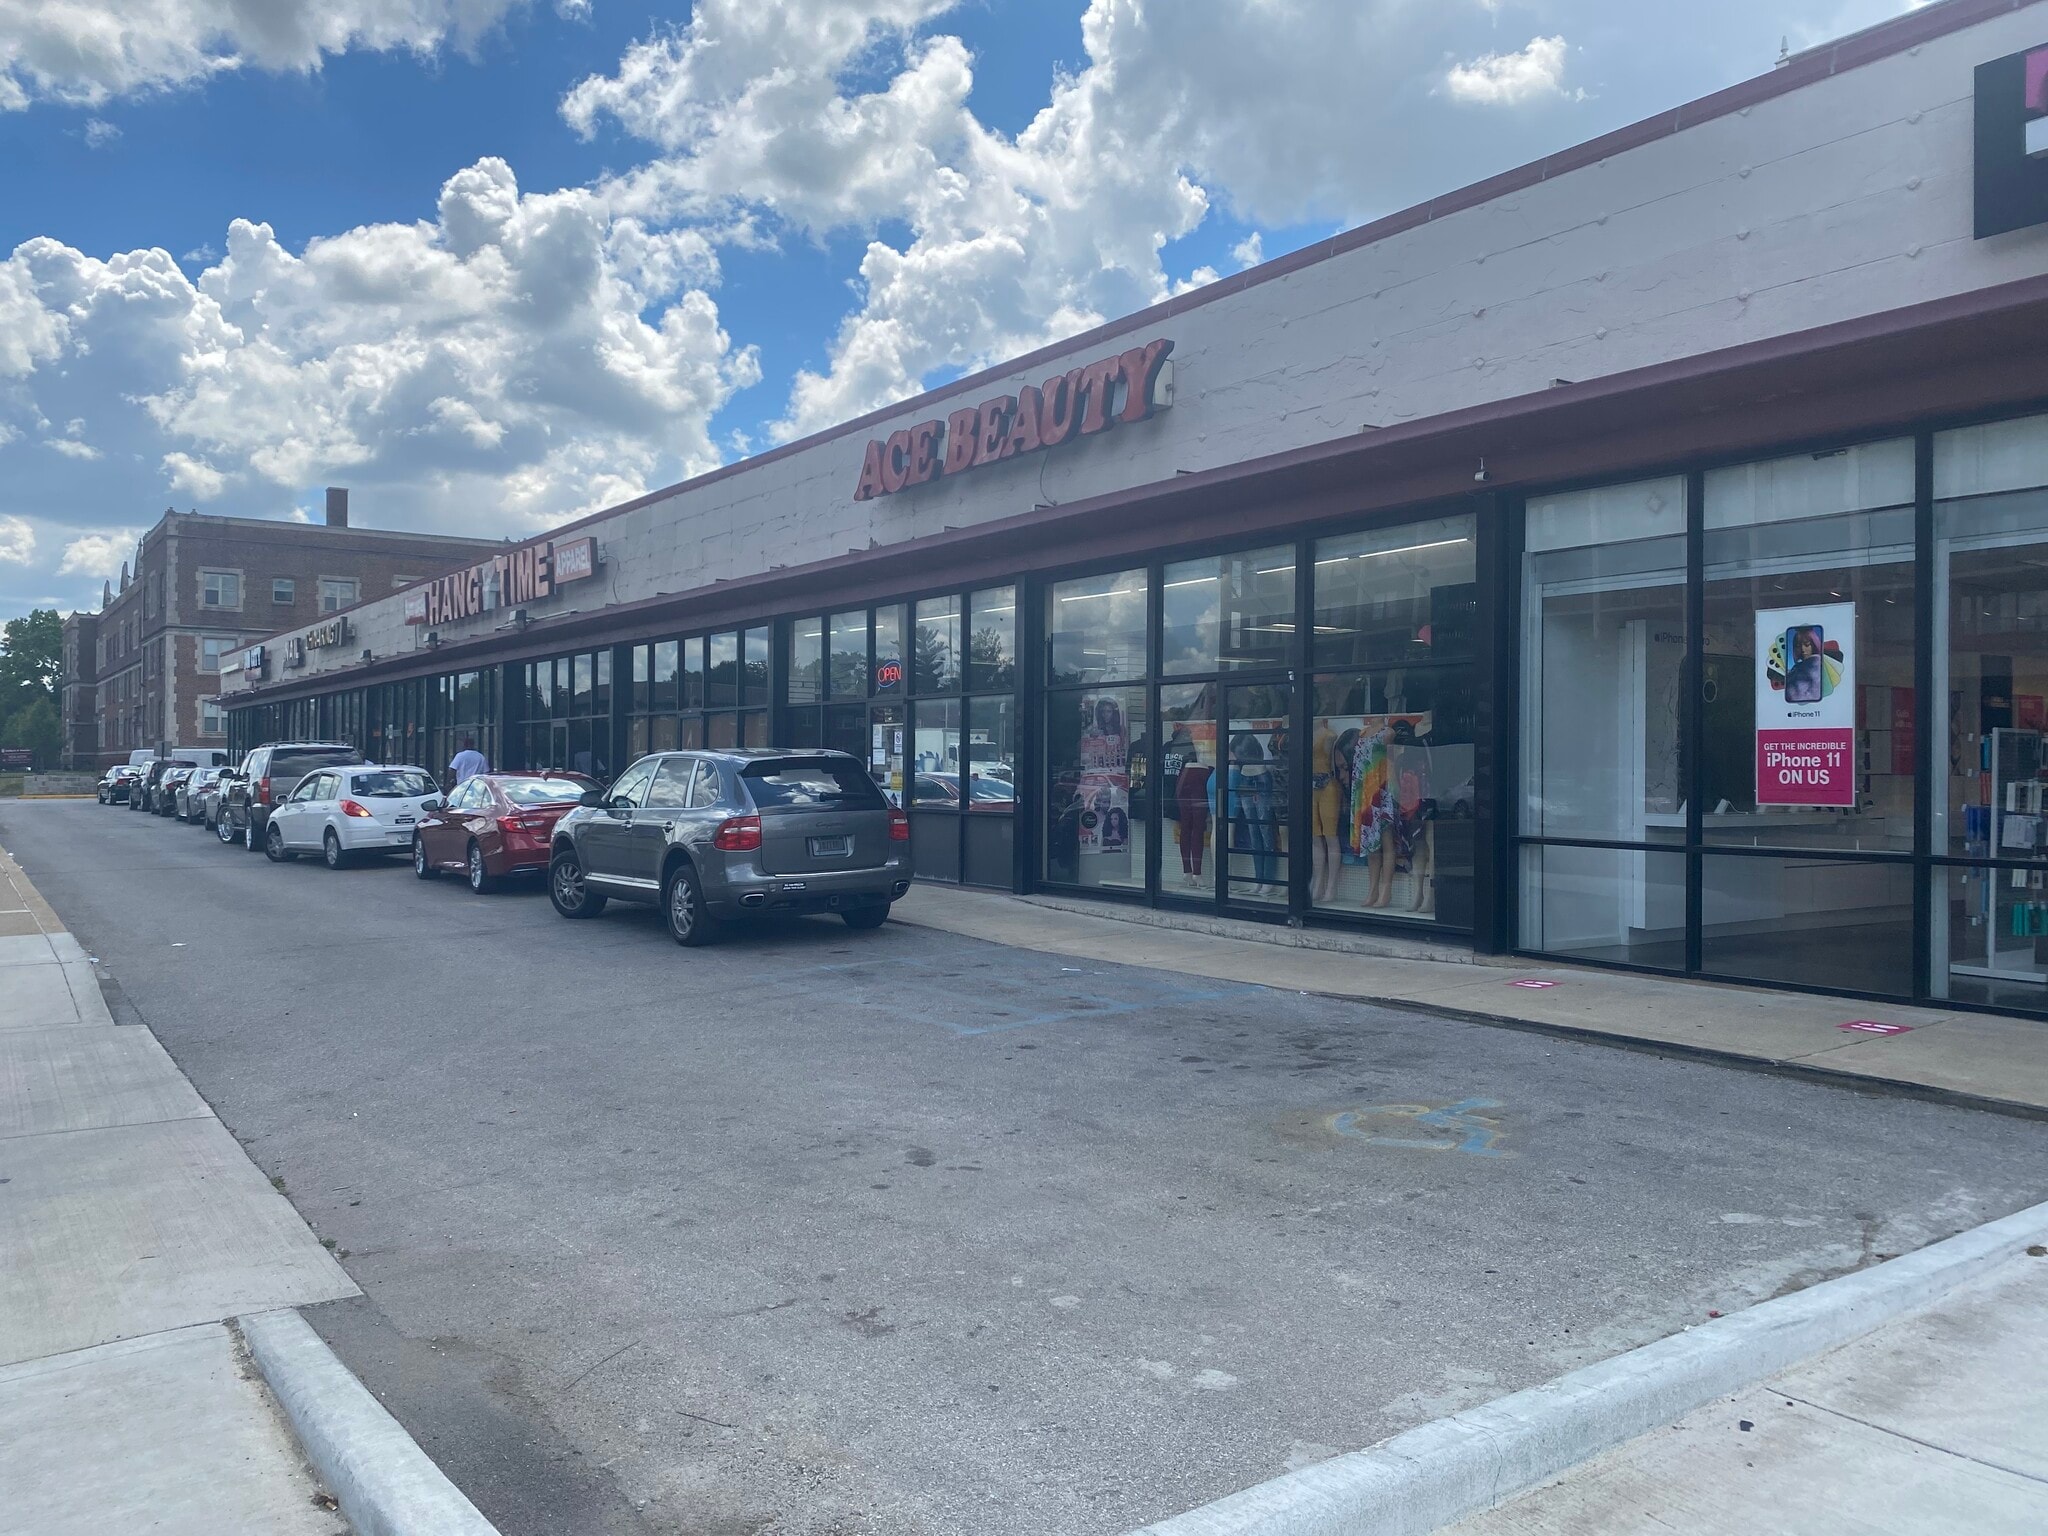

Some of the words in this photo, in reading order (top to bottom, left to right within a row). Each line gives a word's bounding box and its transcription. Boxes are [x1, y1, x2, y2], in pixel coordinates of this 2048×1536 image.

[854, 419, 945, 501] ACE
[943, 338, 1175, 475] BEAUTY
[556, 543, 592, 576] APPAREL
[428, 567, 481, 626] HANG
[496, 543, 552, 606] TIME
[878, 667, 901, 682] OPEN
[1797, 742, 1846, 750] INCREDIBLE
[1767, 753, 1821, 767] iPhone
[1826, 752, 1840, 767] 11
[1779, 769, 1803, 784] ON
[1807, 769, 1830, 784] US
